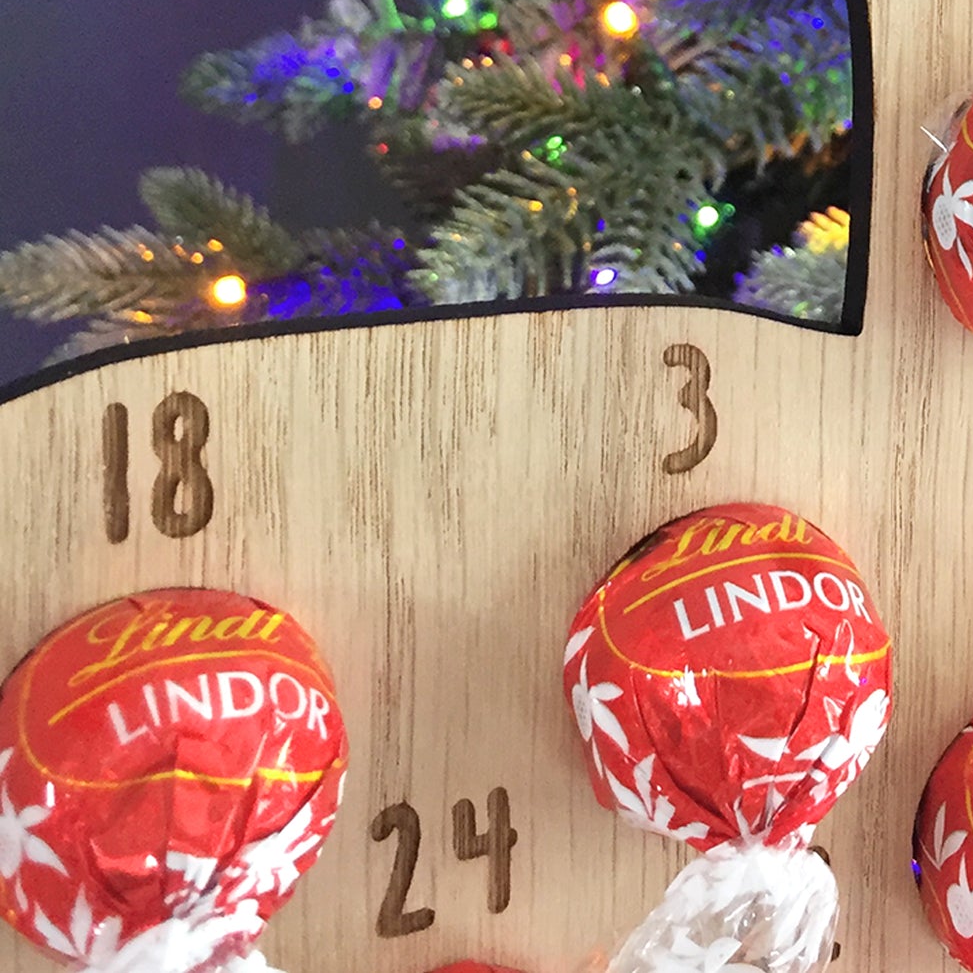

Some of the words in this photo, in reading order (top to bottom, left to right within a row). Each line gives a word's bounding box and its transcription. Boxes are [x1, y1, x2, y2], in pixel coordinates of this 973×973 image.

[663, 343, 718, 476] 3
[102, 390, 214, 544] 18
[641, 513, 815, 581] Lindt
[68, 600, 285, 687] Lindt
[673, 570, 873, 640] LINDOR
[108, 672, 330, 745] LINDOR
[371, 785, 518, 938] 24
